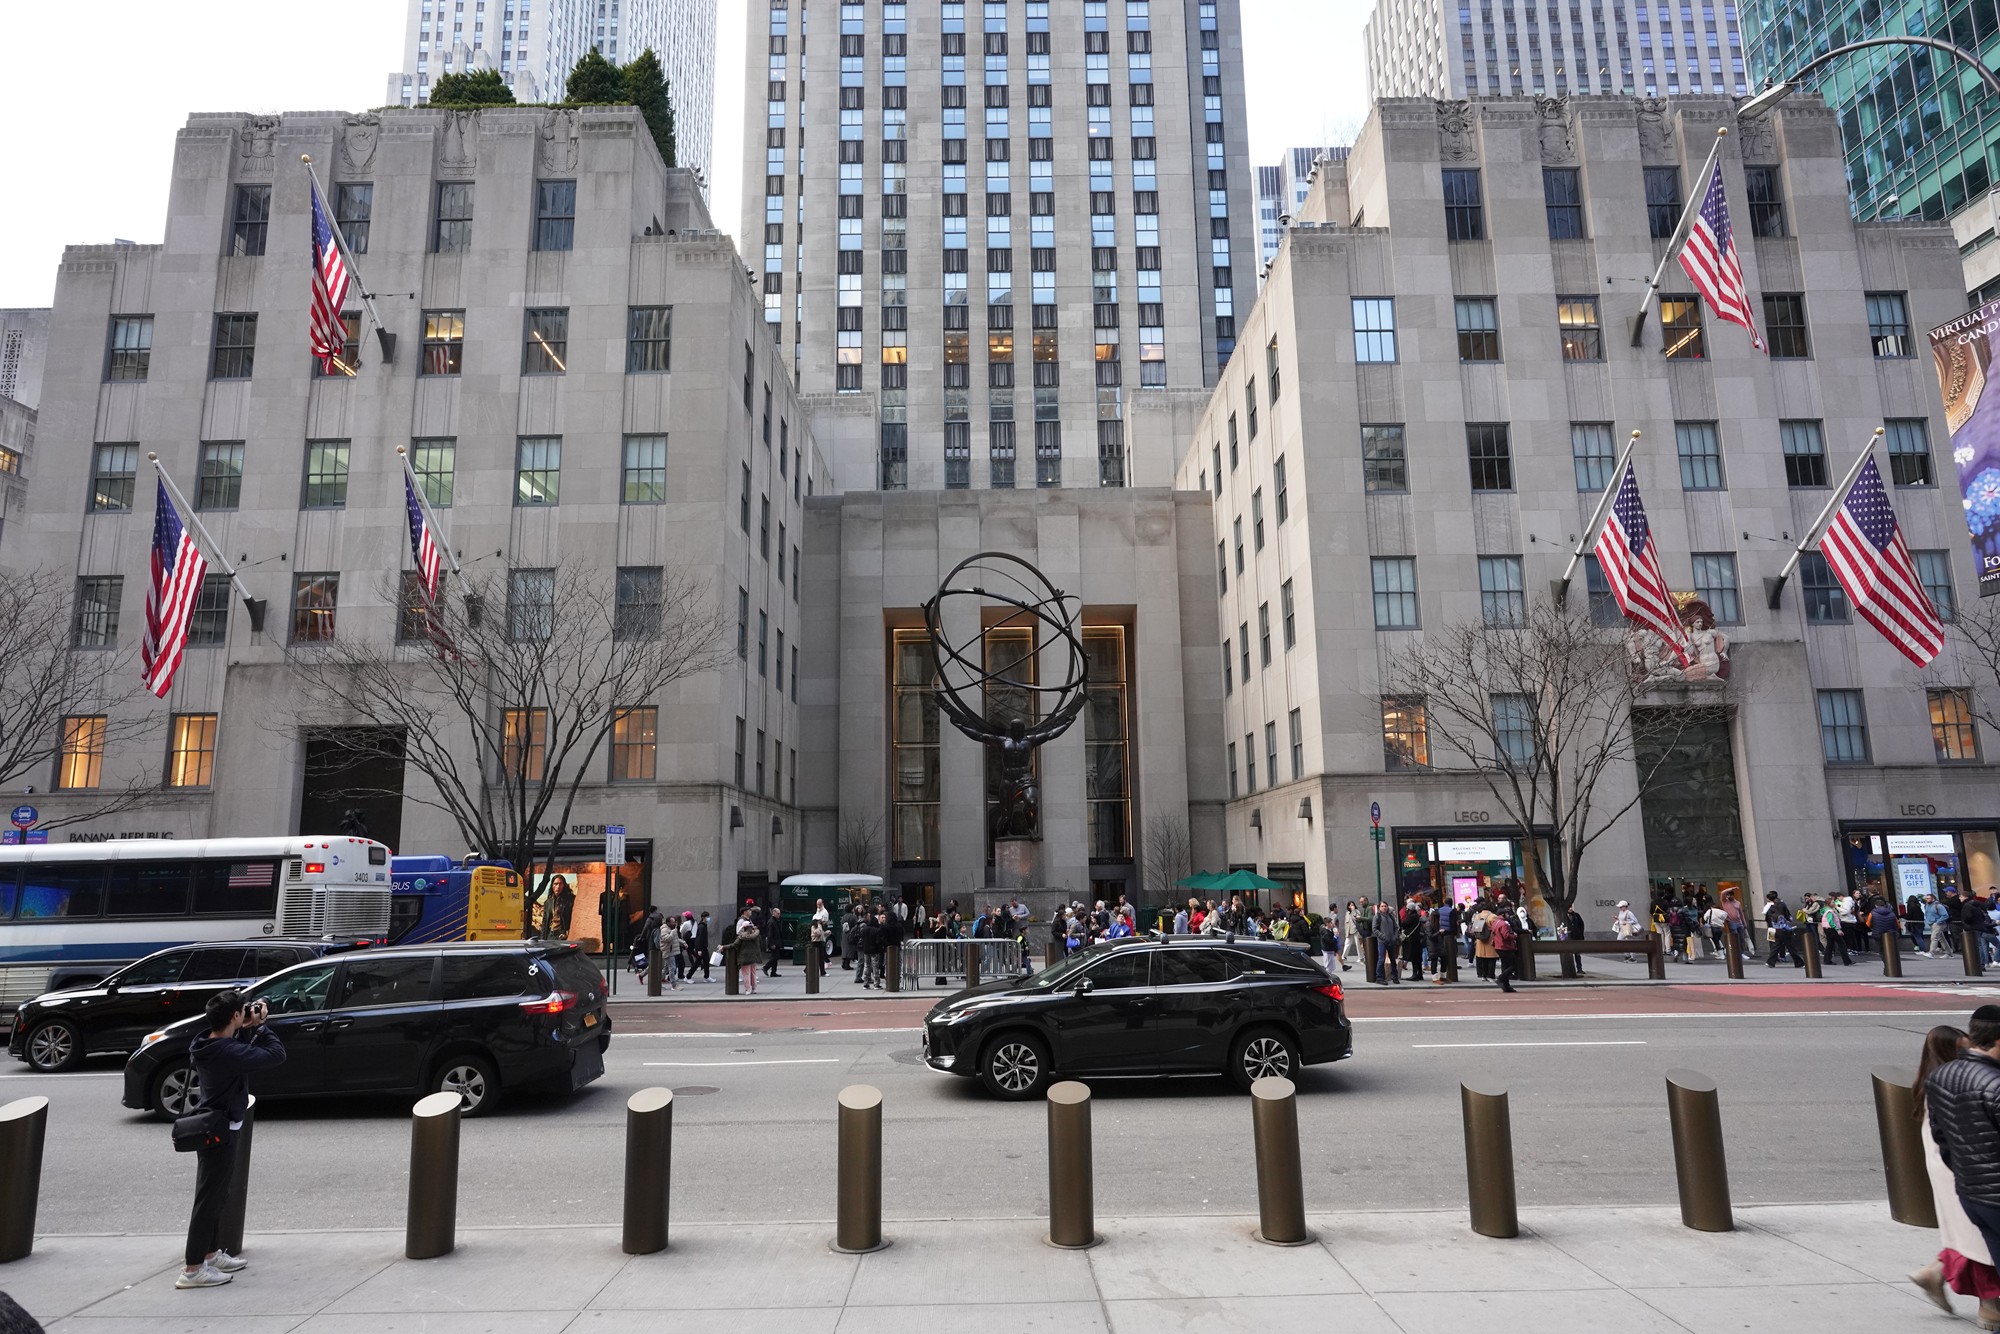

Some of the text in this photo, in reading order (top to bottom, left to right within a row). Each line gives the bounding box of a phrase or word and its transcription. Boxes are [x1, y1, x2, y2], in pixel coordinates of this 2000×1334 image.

[1930, 309, 1989, 340] VIRTUAL
[1958, 318, 2000, 345] CAND
[1901, 804, 1936, 816] LEGO
[1454, 811, 1490, 823] LEGO
[354, 872, 369, 882] 3403
[391, 881, 411, 891] BUS
[1595, 899, 1616, 907] LEGO
